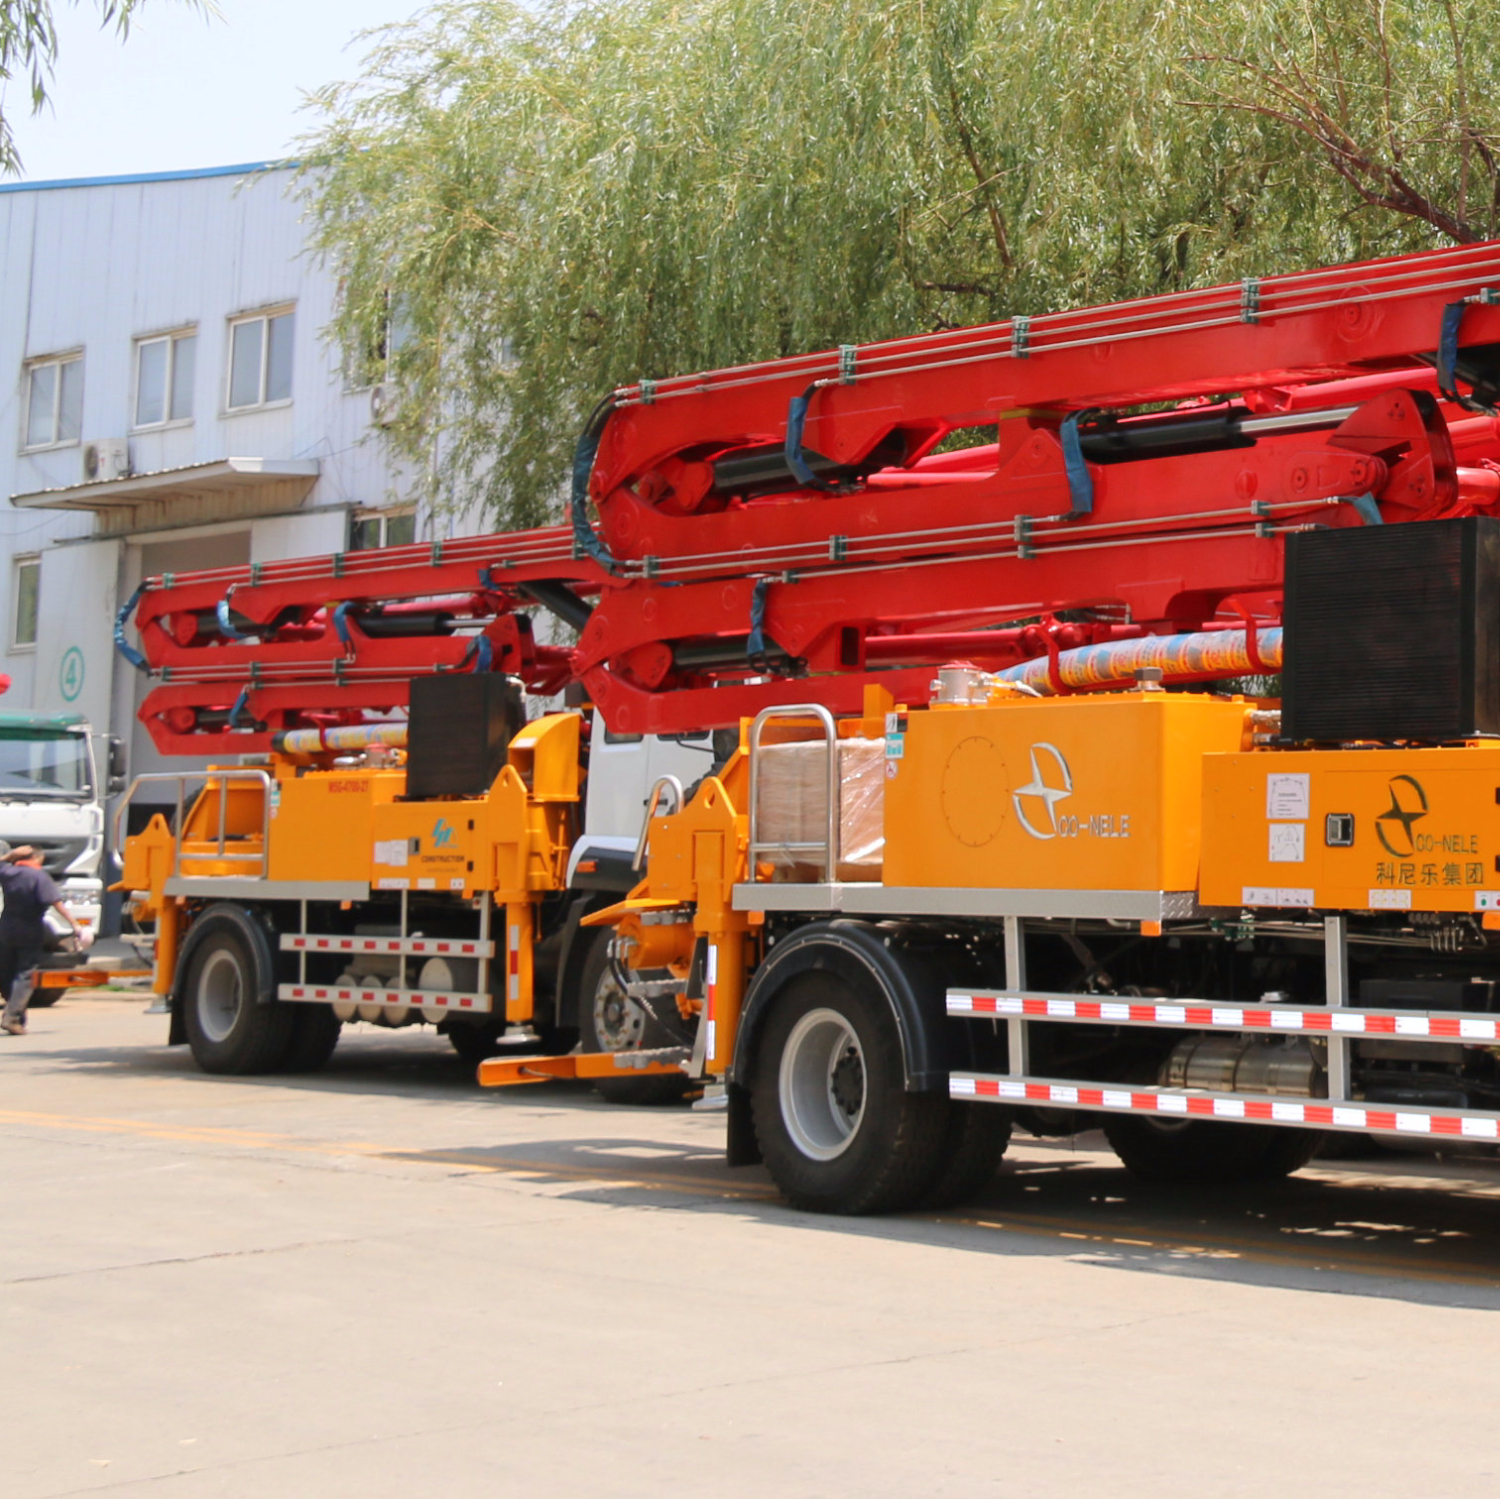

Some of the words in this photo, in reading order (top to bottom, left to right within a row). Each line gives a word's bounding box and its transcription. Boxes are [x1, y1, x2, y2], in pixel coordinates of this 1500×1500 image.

[1059, 814, 1130, 838] CO-NELE
[1415, 833, 1479, 854] CO-NELE
[1375, 861, 1484, 886] 科尼乐集团
